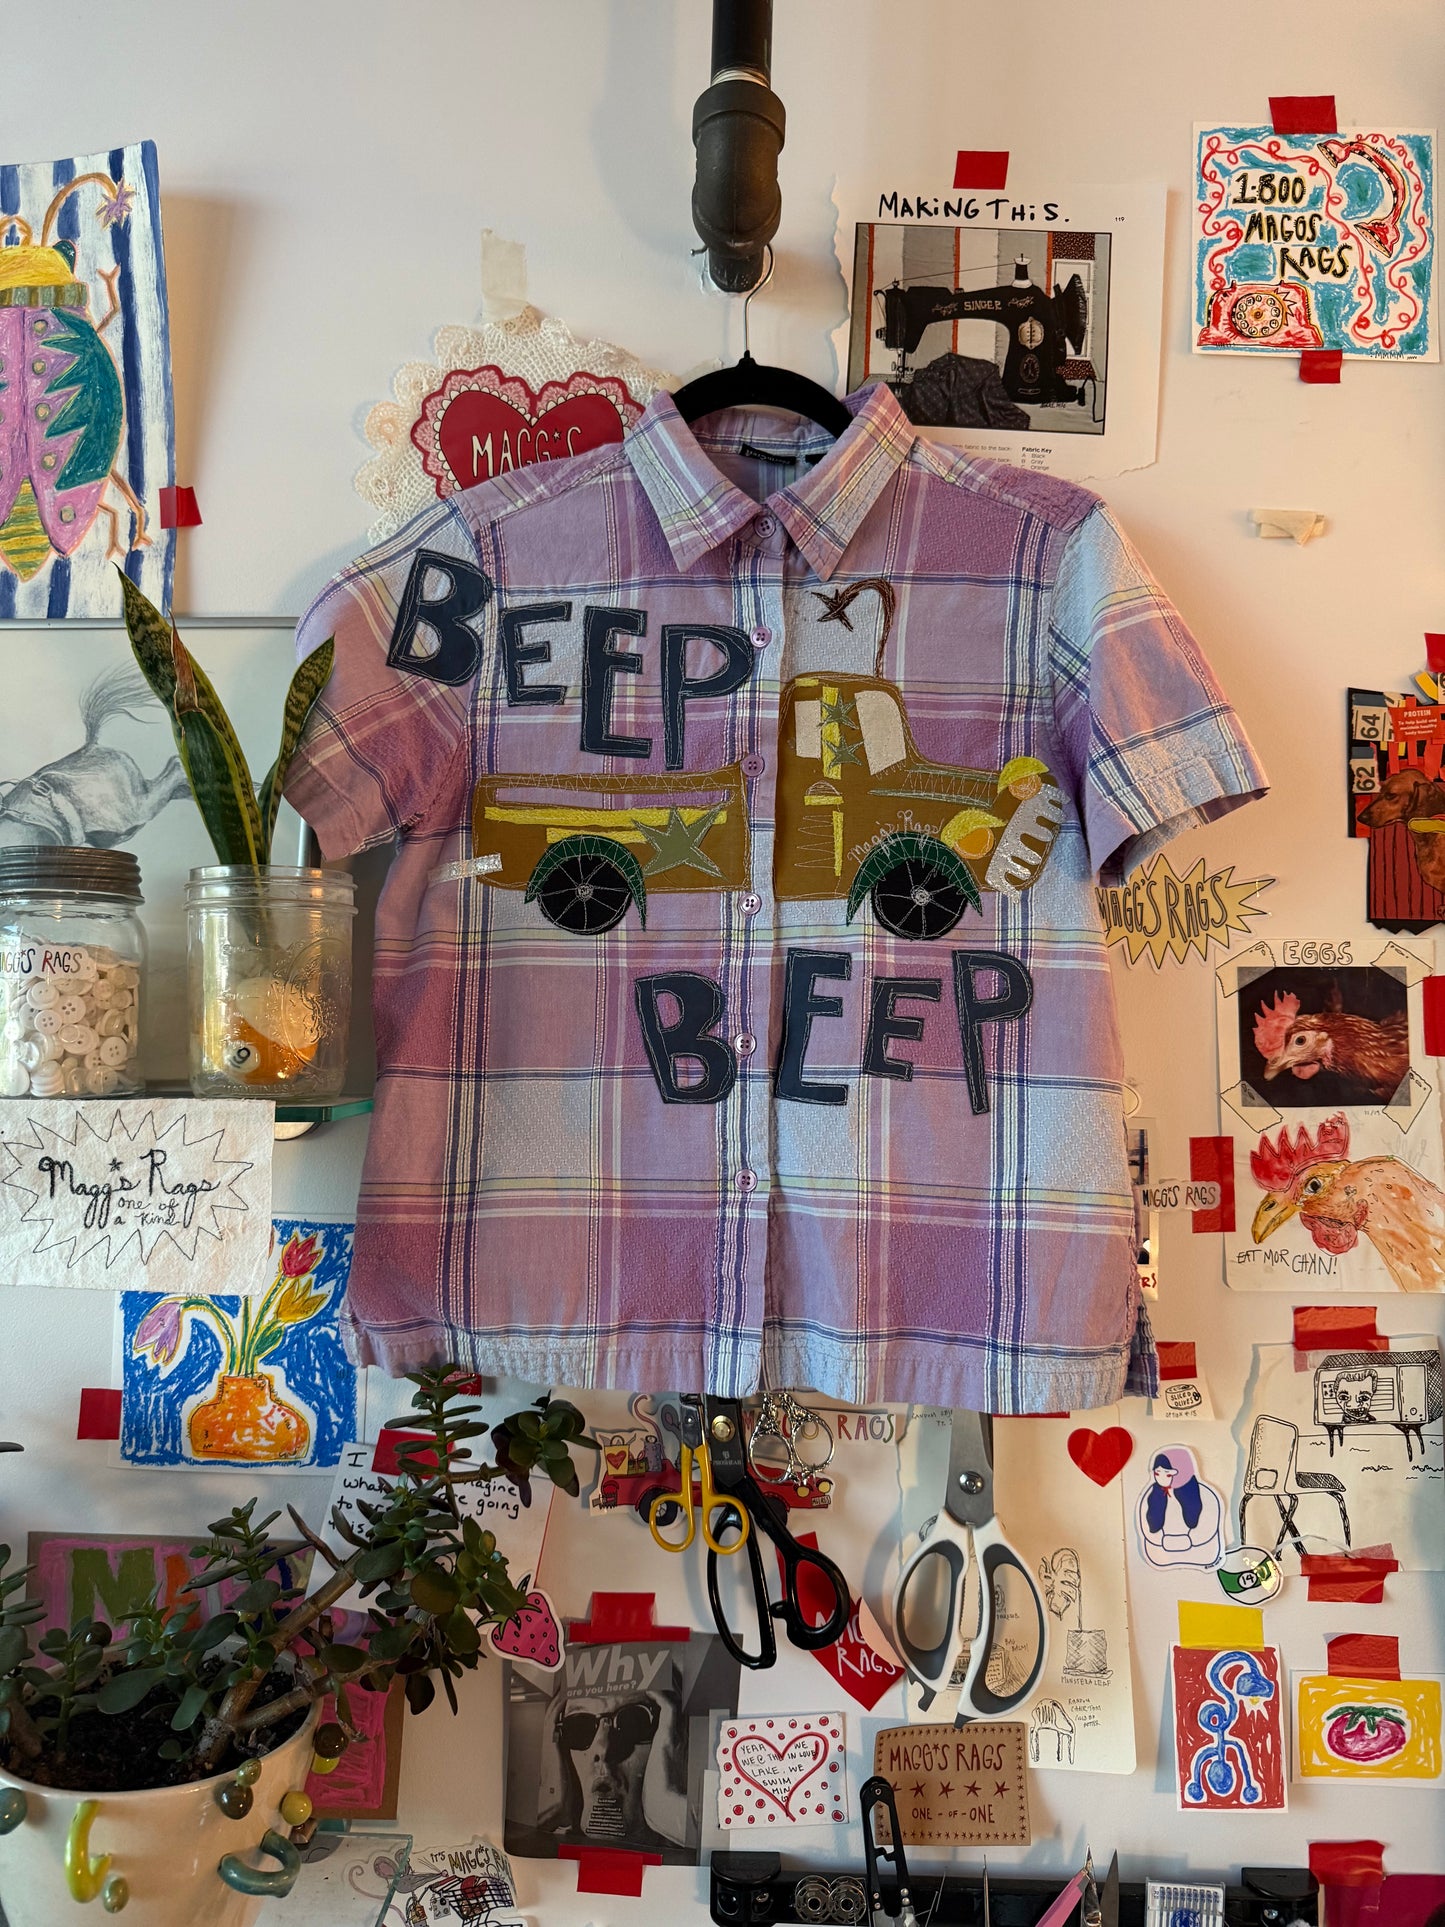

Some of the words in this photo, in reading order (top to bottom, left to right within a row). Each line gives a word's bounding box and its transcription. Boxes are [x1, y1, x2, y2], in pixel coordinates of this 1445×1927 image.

[1280, 244, 1352, 280] RAGS
[963, 300, 1002, 311] SINGER
[386, 549, 754, 771] BEEP
[1403, 709, 1432, 718] PROTEIN
[1361, 714, 1380, 739] 64
[1356, 766, 1376, 792] 62
[1164, 876, 1228, 943] RAGS
[41, 950, 83, 974] RAGS
[1283, 941, 1353, 966] EGGS
[635, 947, 1033, 1115] BEEP
[140, 1148, 221, 1229] Rags
[1185, 1186, 1216, 1207] RAGS
[118, 1197, 150, 1210] one
[159, 1198, 179, 1211] of
[114, 1217, 125, 1225] a
[1236, 1249, 1262, 1264] EAT
[1264, 1248, 1289, 1267] MOR
[1174, 1397, 1194, 1407] OLIVES
[838, 1414, 894, 1443] RAGS
[476, 1500, 520, 1520] going
[1242, 1574, 1254, 1586] 14
[565, 1645, 671, 1691] Why
[567, 1687, 583, 1697] are
[585, 1686, 604, 1697] you
[606, 1680, 638, 1693] here?
[794, 1741, 808, 1749] WE
[787, 1752, 797, 1760] IN
[956, 1744, 1006, 1771] RAGS
[788, 1764, 804, 1773] WE
[762, 1777, 791, 1786] SWIM
[772, 1786, 791, 1795] MIN
